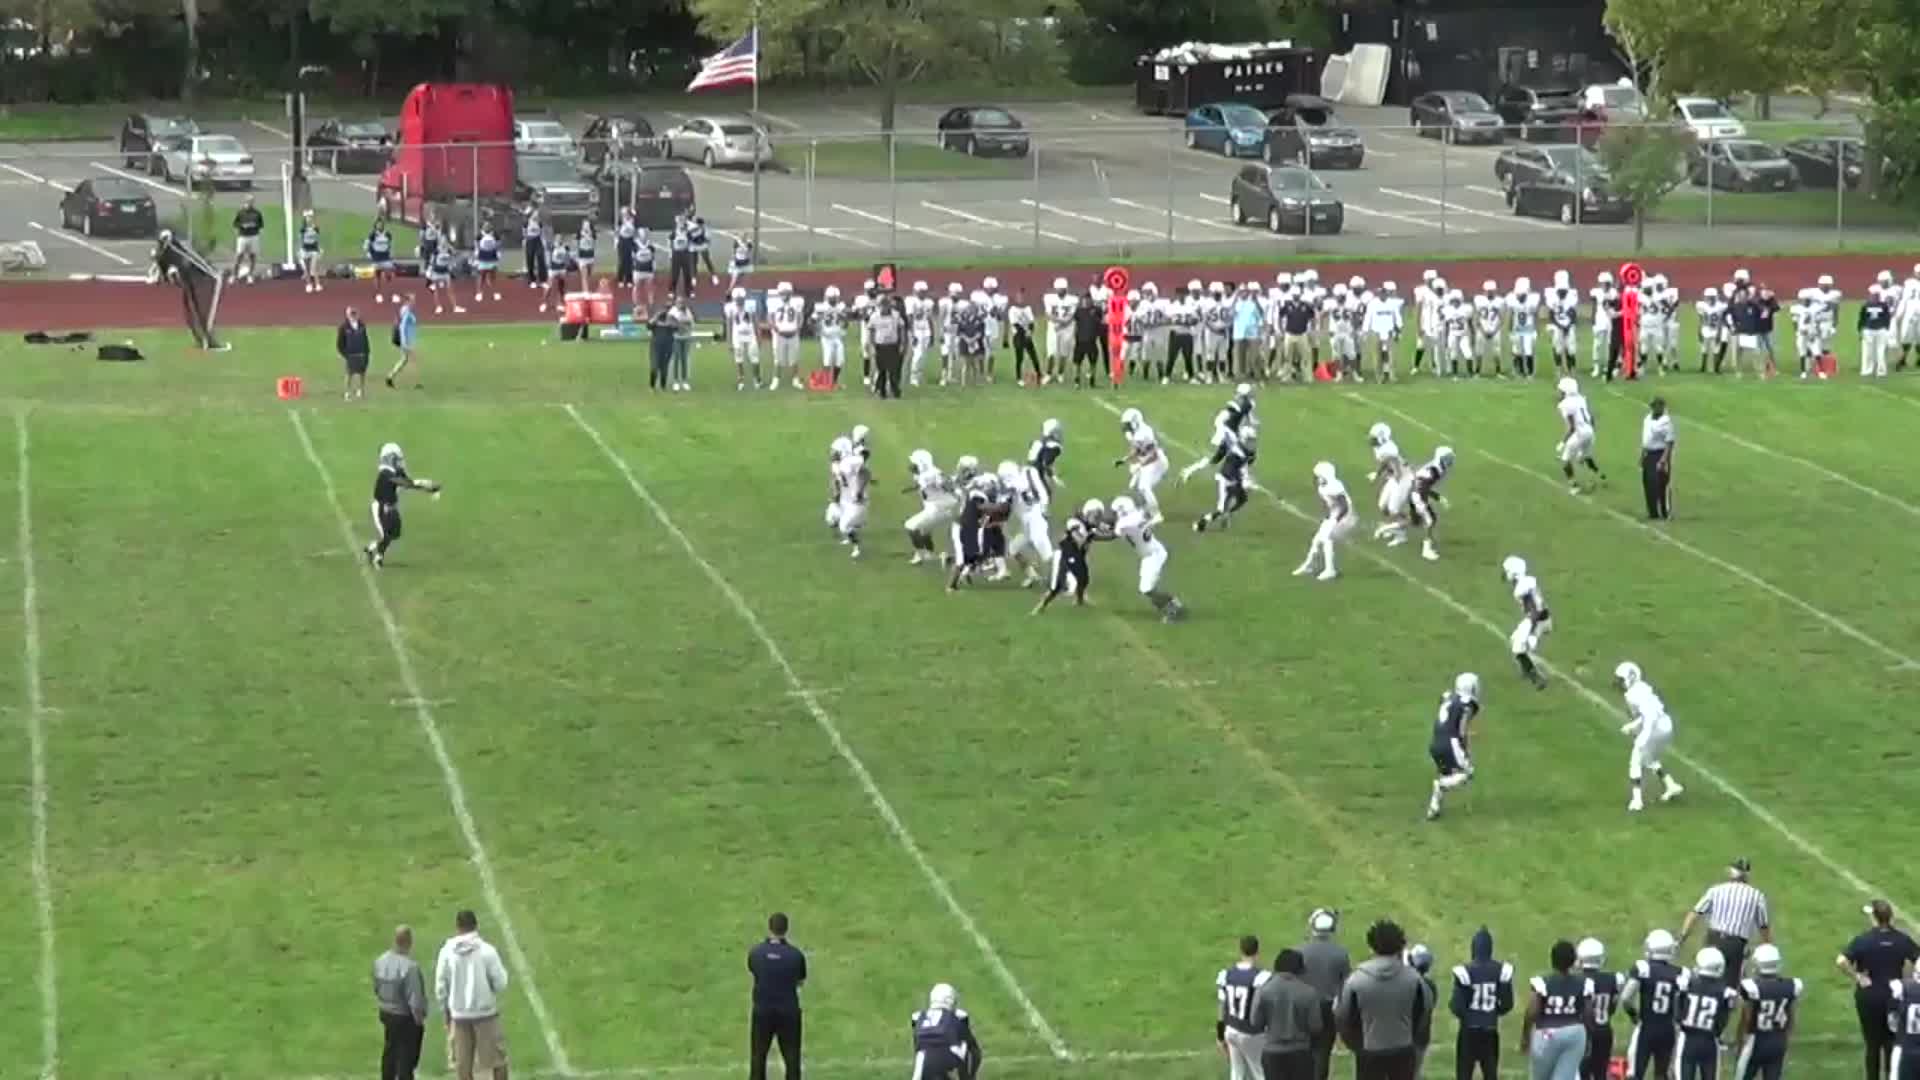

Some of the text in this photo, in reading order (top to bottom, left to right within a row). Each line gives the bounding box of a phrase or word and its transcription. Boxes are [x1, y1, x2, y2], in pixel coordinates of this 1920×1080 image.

[1225, 984, 1249, 1021] 17
[1681, 993, 1718, 1031] 12
[1756, 997, 1788, 1032] 24
